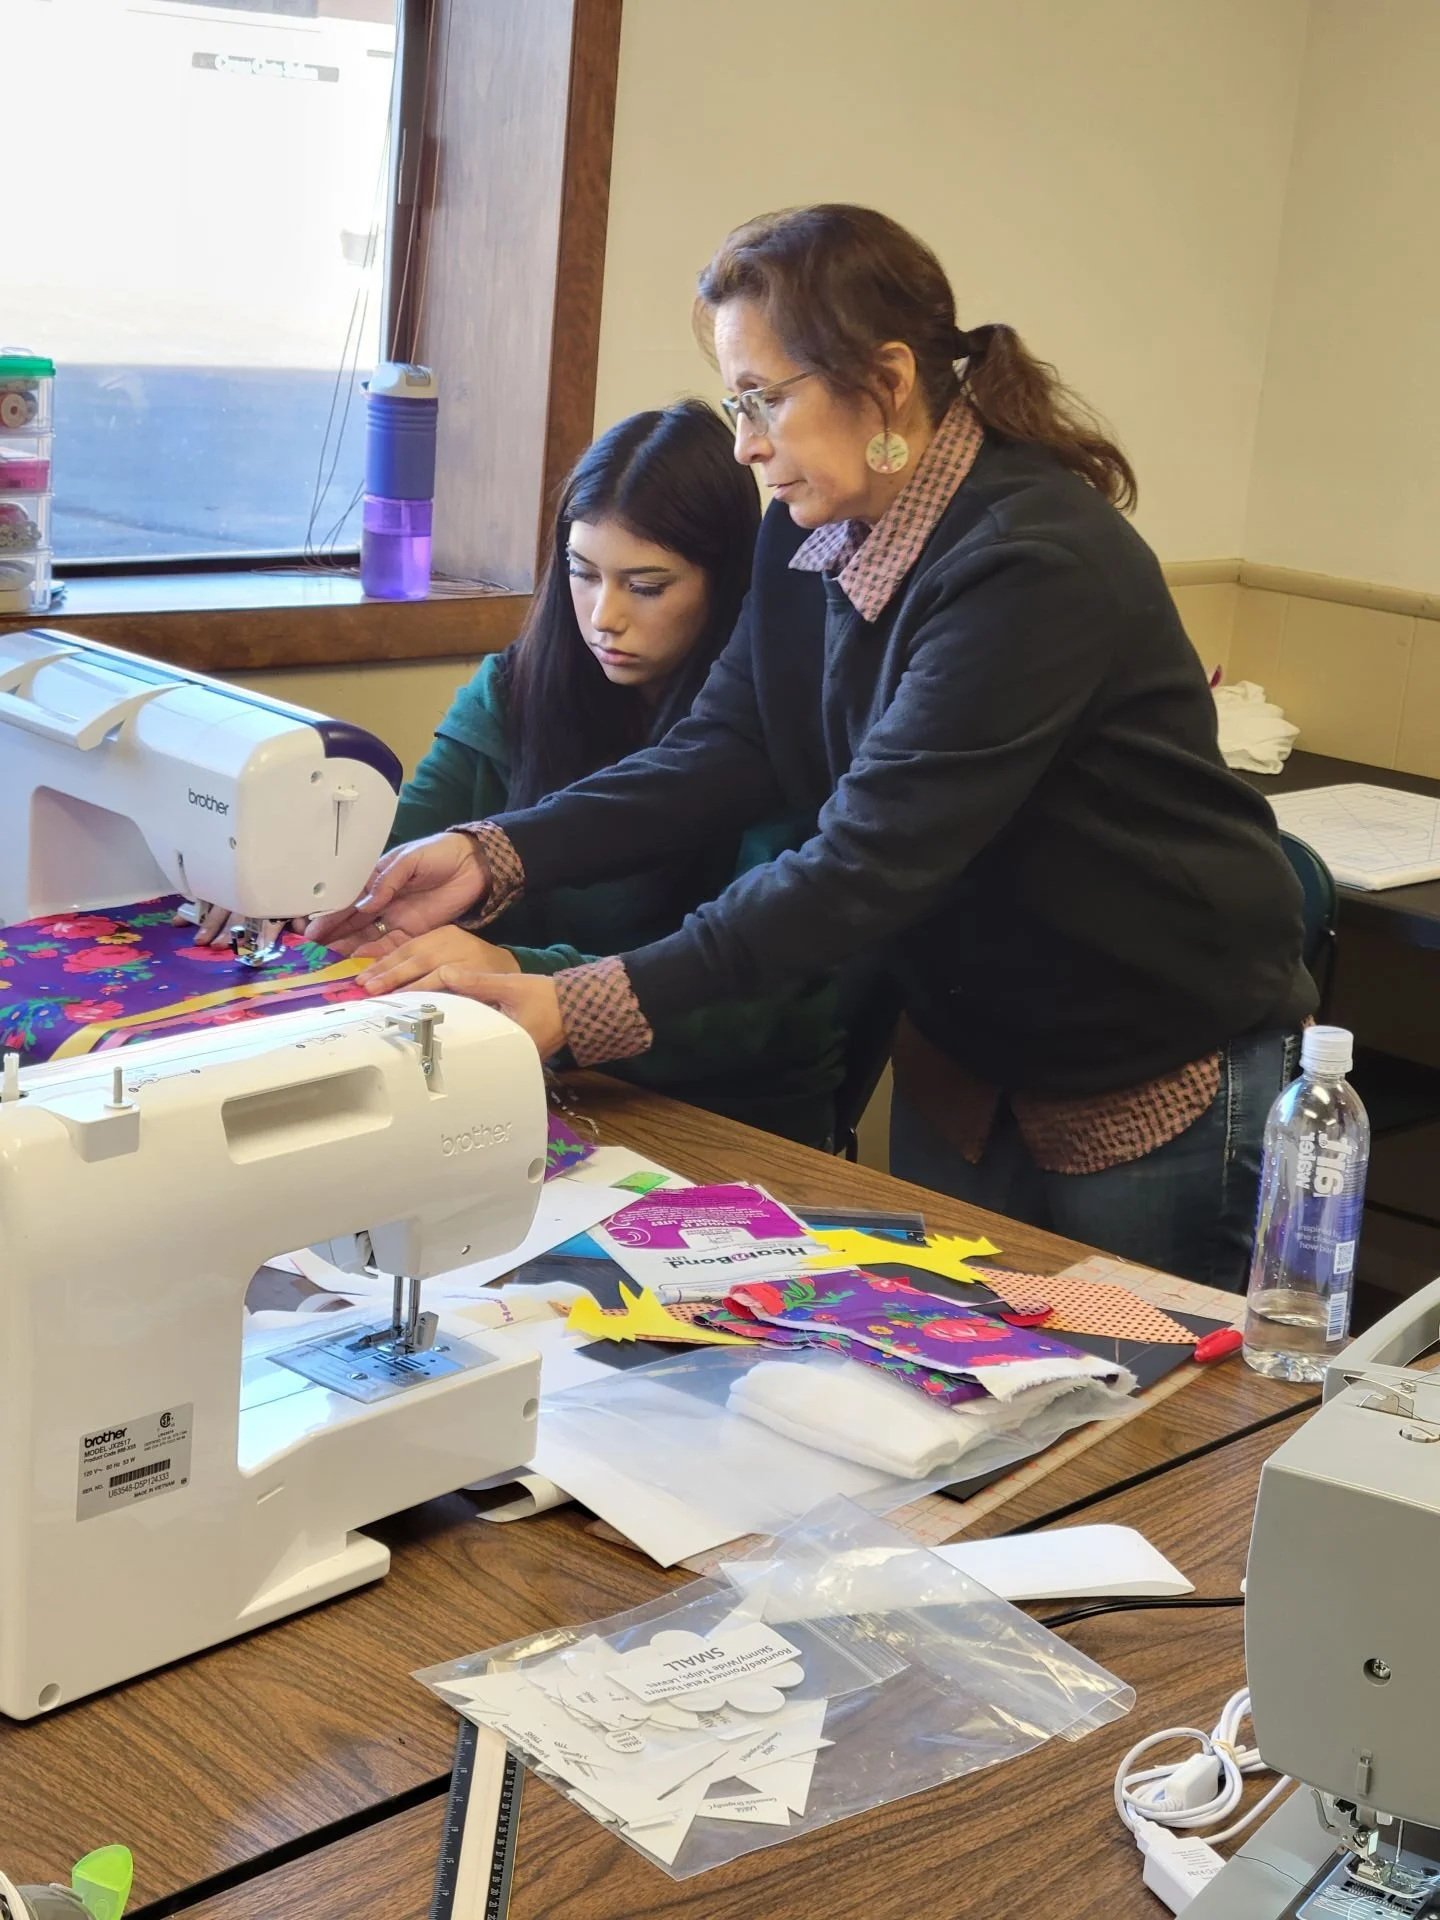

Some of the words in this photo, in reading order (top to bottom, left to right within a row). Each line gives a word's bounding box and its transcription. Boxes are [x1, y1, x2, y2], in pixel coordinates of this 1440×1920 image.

[188, 787, 229, 816] brother
[440, 1122, 512, 1157] brother
[84, 1427, 128, 1449] brother
[84, 1446, 107, 1458] MODEL
[662, 1646, 726, 1672] SMALL
[709, 1647, 793, 1682] Rounded/Pointed
[711, 1644, 774, 1671] Skinny/Wide
[683, 1678, 710, 1691] Petal
